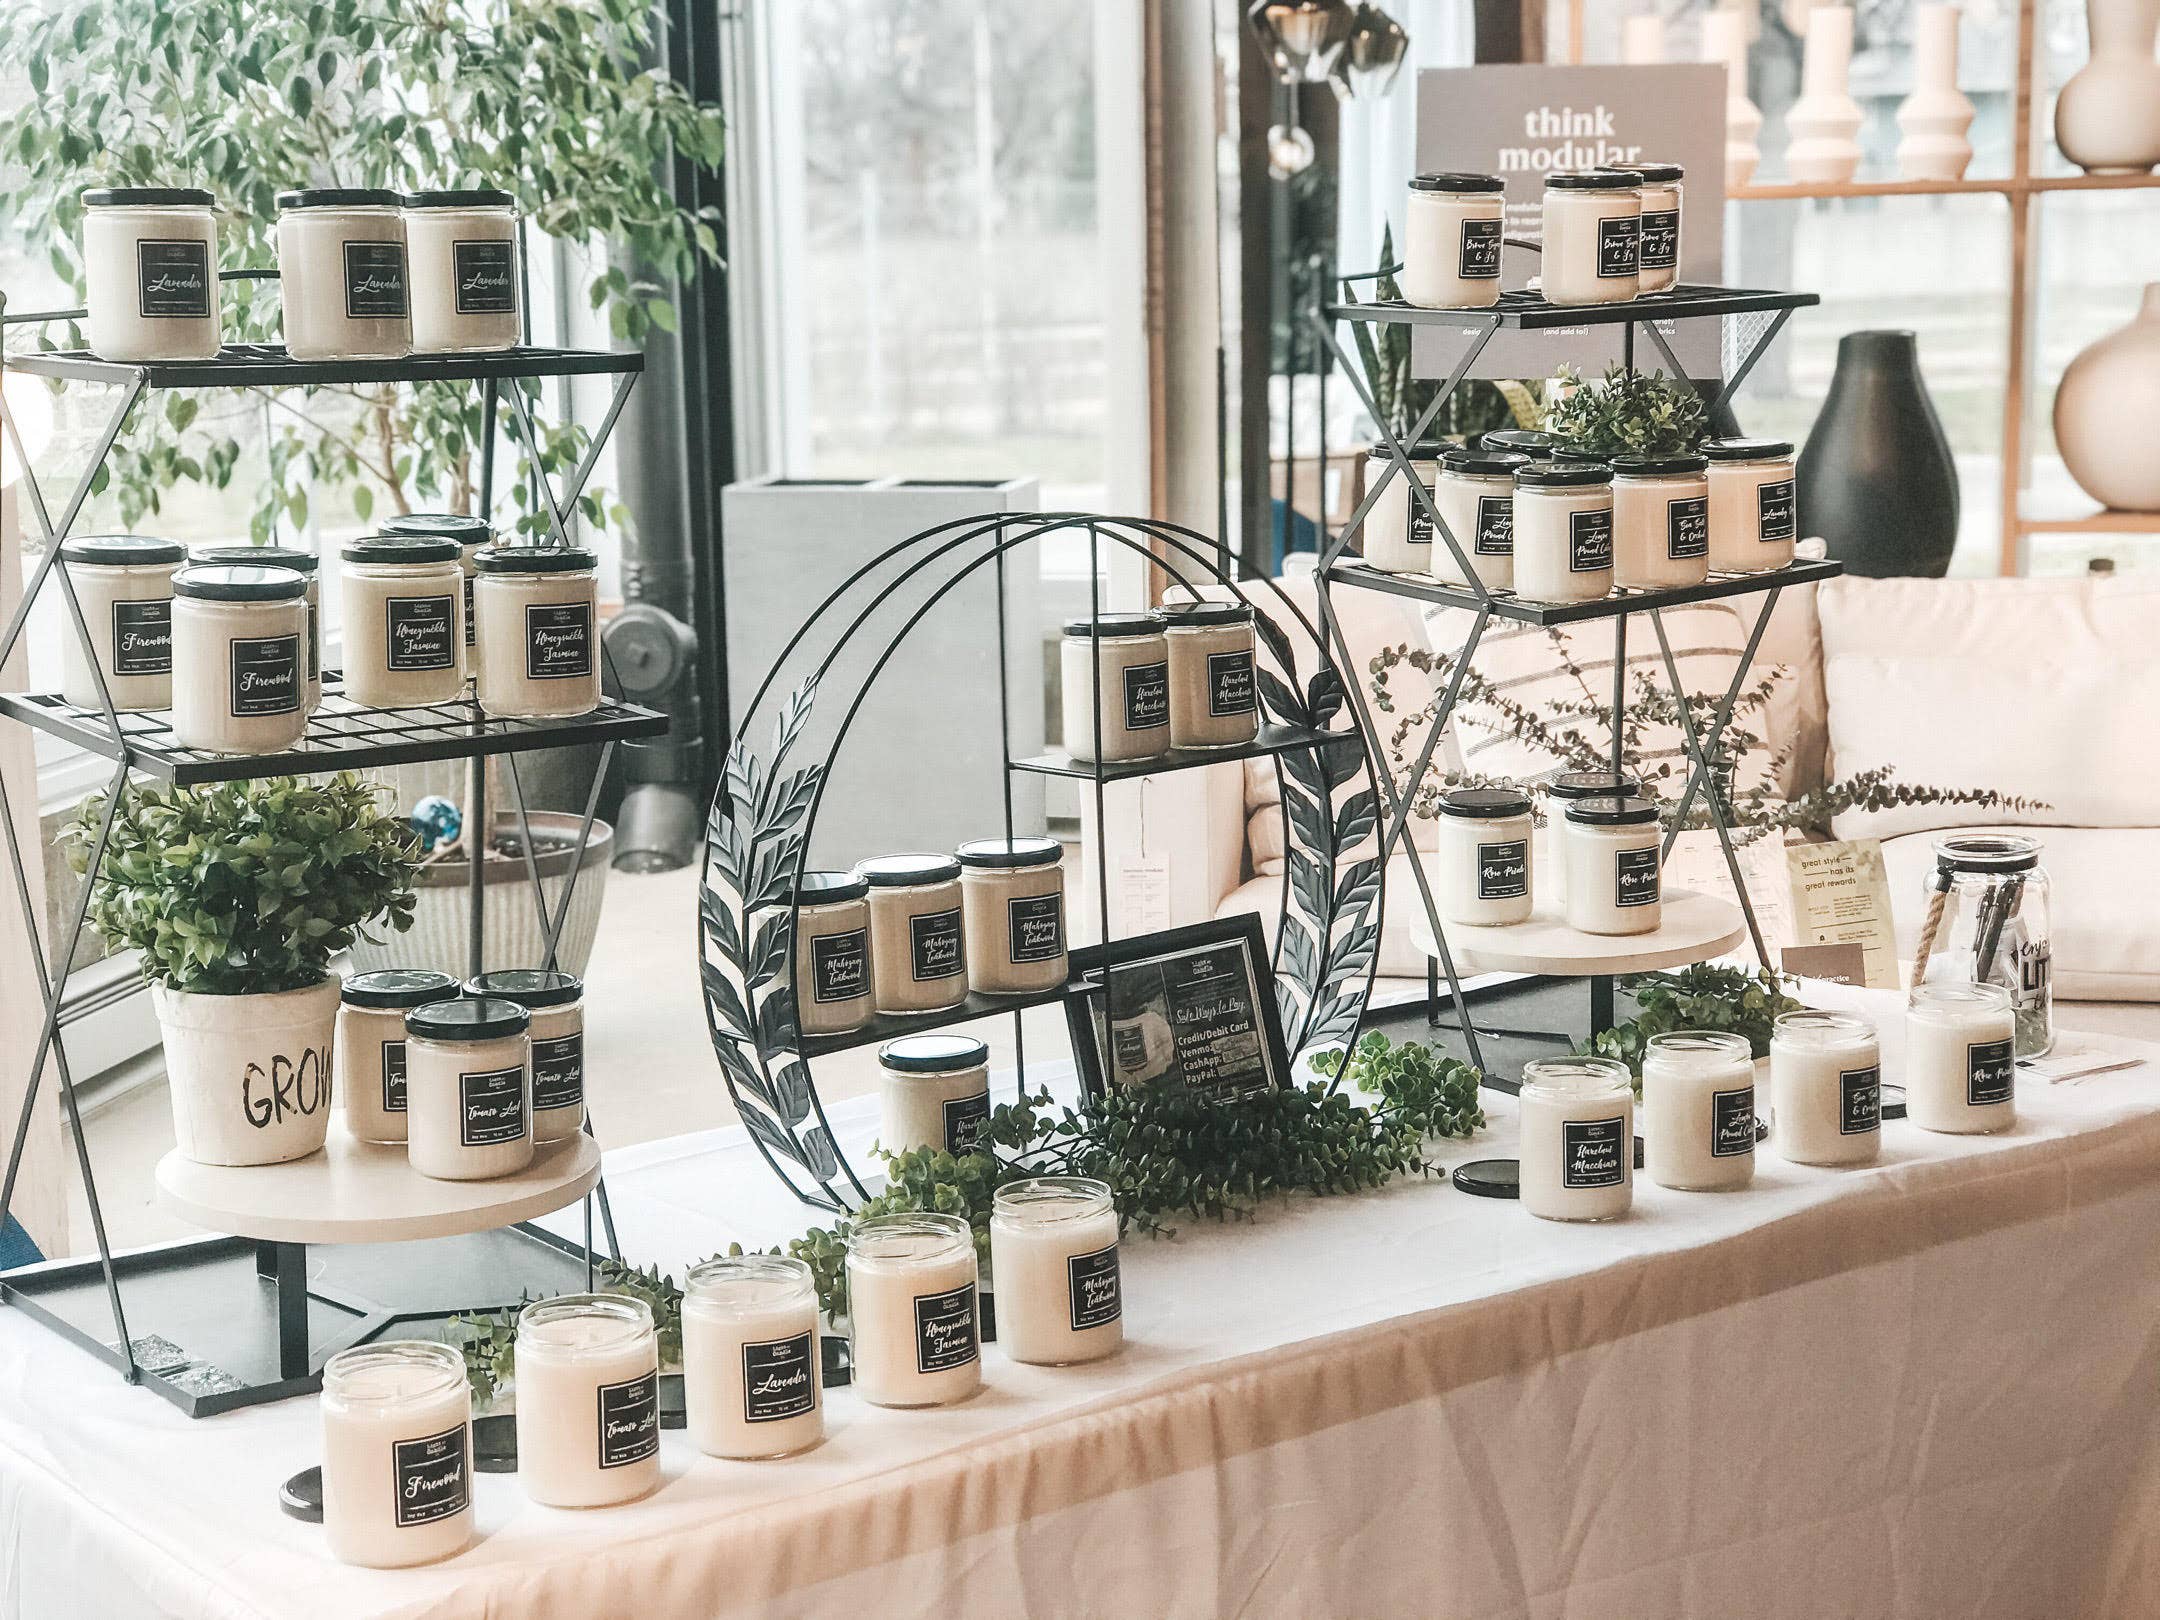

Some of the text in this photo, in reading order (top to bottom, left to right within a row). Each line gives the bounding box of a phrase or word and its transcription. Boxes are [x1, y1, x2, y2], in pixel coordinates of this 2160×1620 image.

[1525, 105, 1616, 138] think
[1499, 140, 1642, 171] modular
[147, 272, 202, 292] Lavender
[353, 273, 401, 293] Lavender
[462, 271, 509, 291] Lavender
[1462, 327, 1482, 337] desig
[396, 620, 447, 640] Honeysuckle
[535, 629, 584, 647] Honeysuckle
[403, 638, 441, 655] Jasmine
[543, 647, 580, 662] Jasmine
[240, 667, 293, 692] Firewood
[1801, 856, 1841, 869] great style
[1845, 865, 1855, 874] its
[1805, 877, 1857, 892] great rewards
[1177, 1020, 1249, 1046] Credit/Debit Card
[389, 1072, 407, 1087] Tom
[1186, 1069, 1217, 1084] PayPal:
[243, 1046, 333, 1128] GROW
[468, 1099, 521, 1121] Tomato Leaf
[1576, 1143, 1613, 1159] Hazelnut
[1570, 1158, 1618, 1174] Macchiato
[933, 1336, 969, 1354] Jasmine
[752, 1367, 807, 1395] Lavender
[607, 1420, 638, 1439] Tomato
[404, 1462, 461, 1499] Firewood
